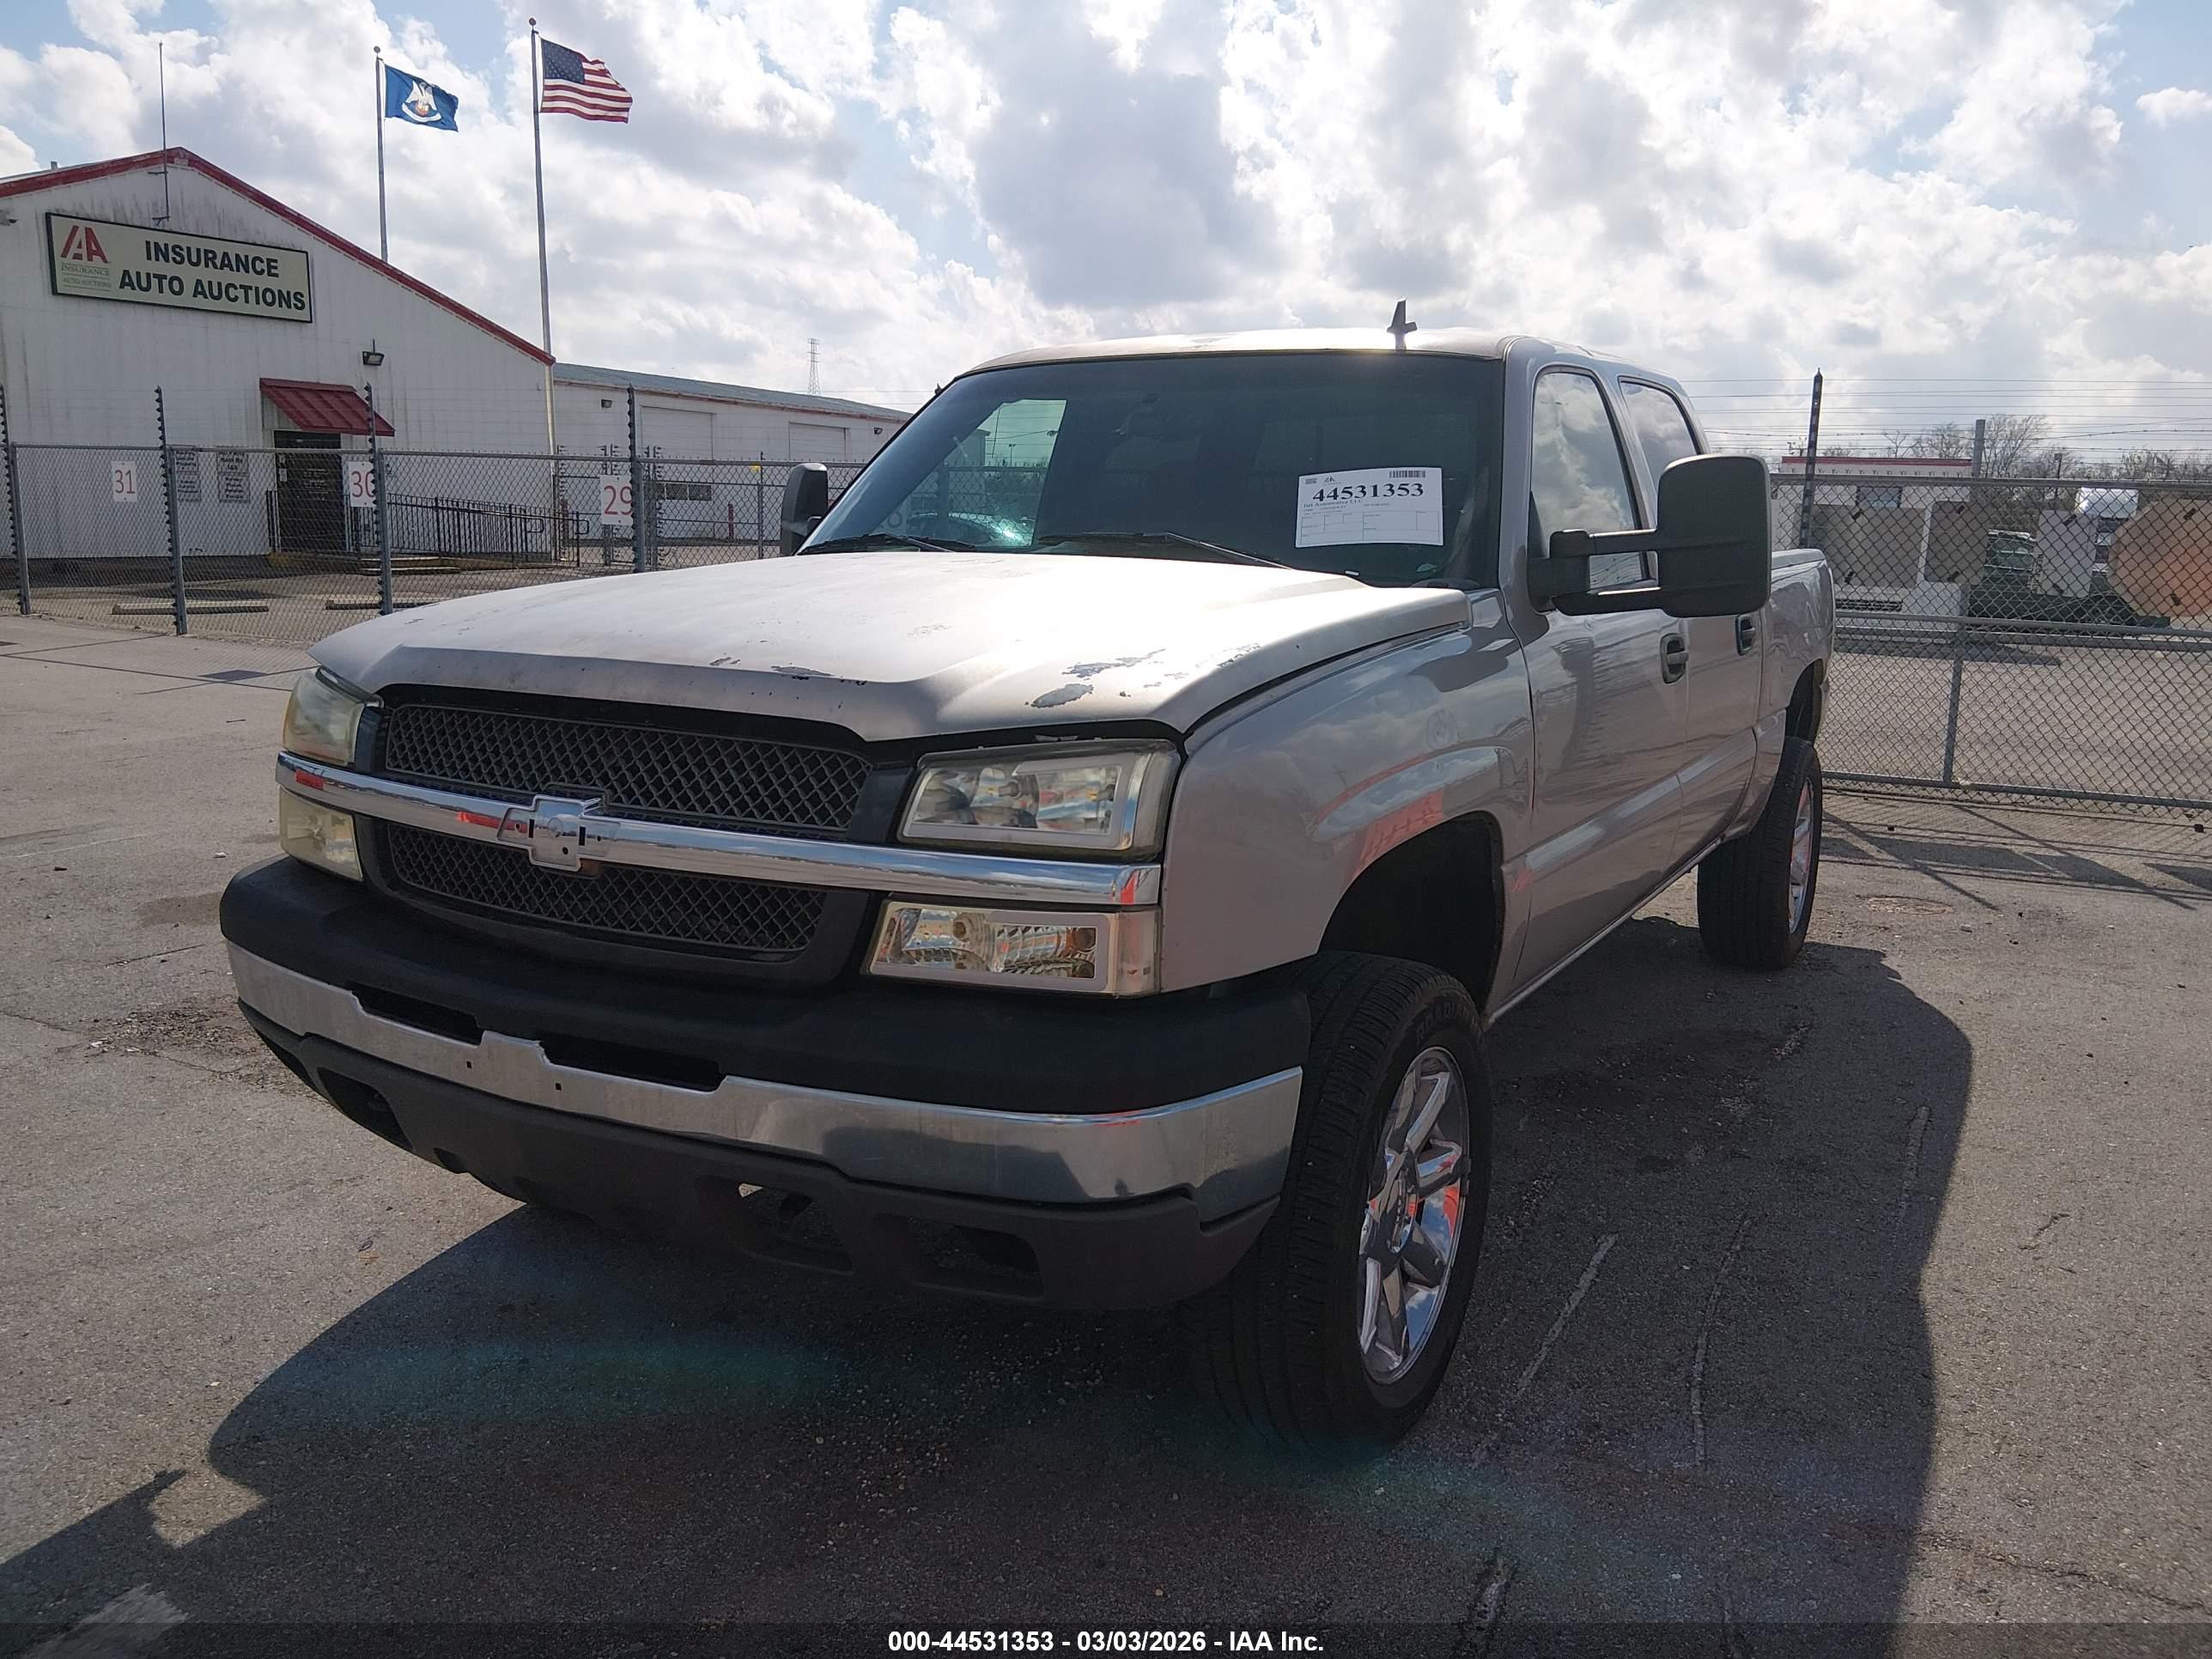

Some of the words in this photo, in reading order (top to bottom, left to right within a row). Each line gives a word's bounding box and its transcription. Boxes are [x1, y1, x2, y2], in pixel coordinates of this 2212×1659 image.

[145, 240, 280, 277] INSURANCE
[118, 269, 185, 296] AUTO
[191, 278, 306, 311] AUCTIONS
[114, 469, 136, 495] 31
[1313, 483, 1424, 502] 44531353
[604, 484, 633, 515] 29
